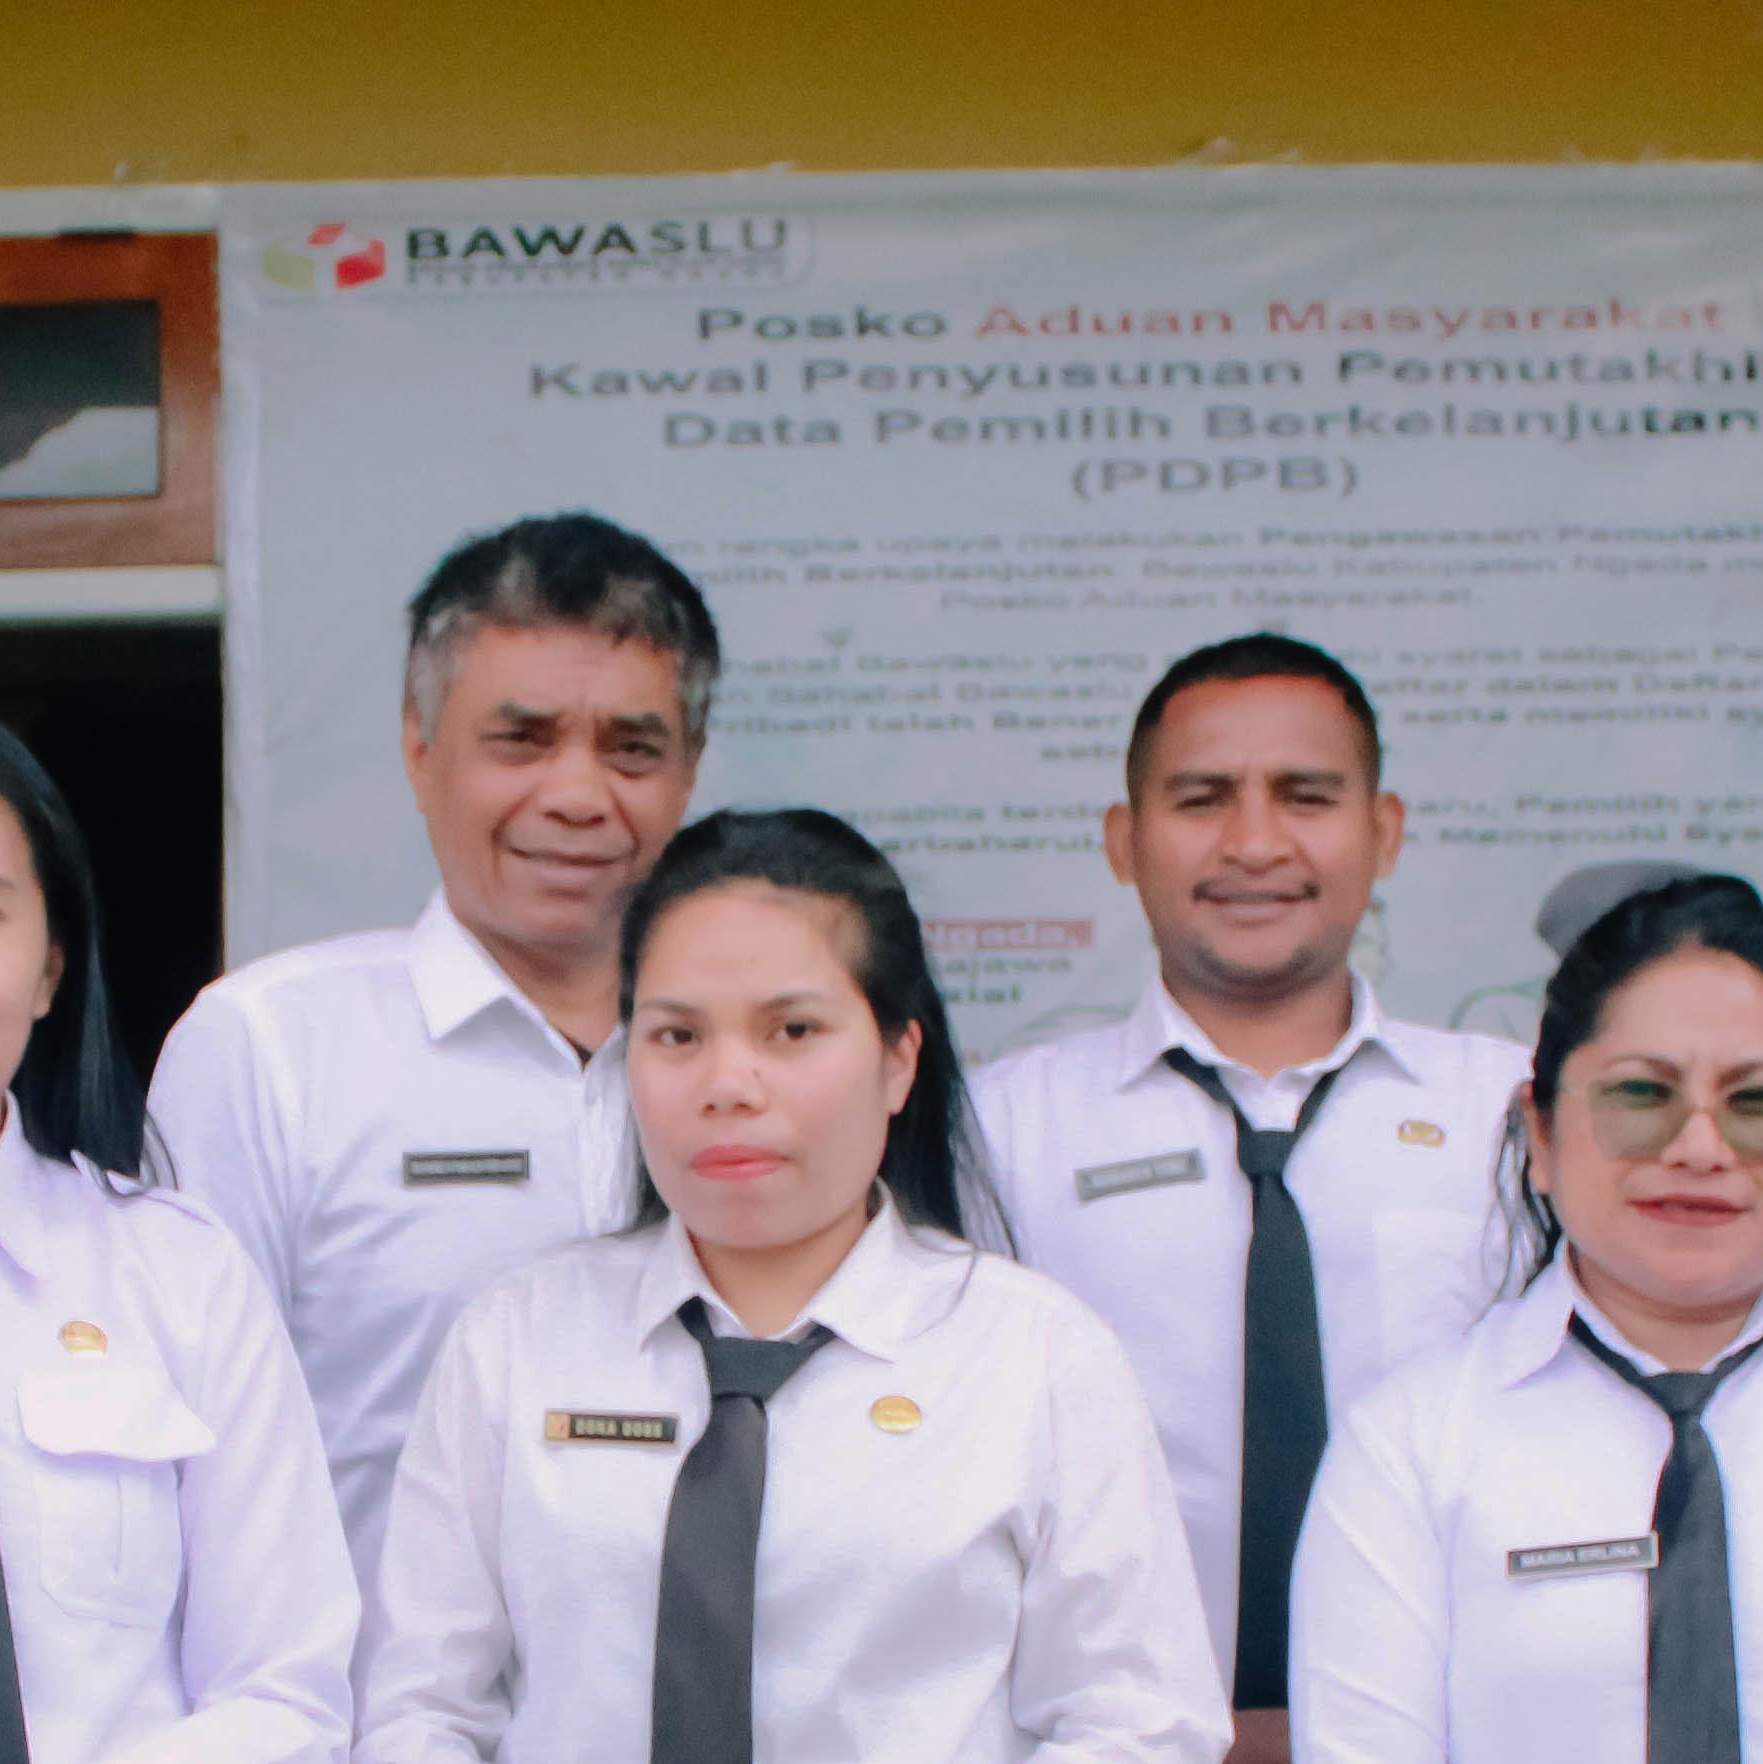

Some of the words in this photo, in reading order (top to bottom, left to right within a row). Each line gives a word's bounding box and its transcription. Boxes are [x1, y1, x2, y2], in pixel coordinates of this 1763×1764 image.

[407, 218, 787, 257] BAWASLU
[698, 306, 945, 340] Posko
[977, 302, 1231, 338] Aduan
[1268, 299, 1726, 339] Masyarakat
[530, 361, 769, 396] Kawal
[803, 355, 1301, 398] Penyusunan
[664, 412, 841, 447] Data
[875, 408, 1169, 444] Pemilih
[1207, 403, 1760, 442] Berkelanjutan
[1073, 454, 1358, 499] (PDPB)
